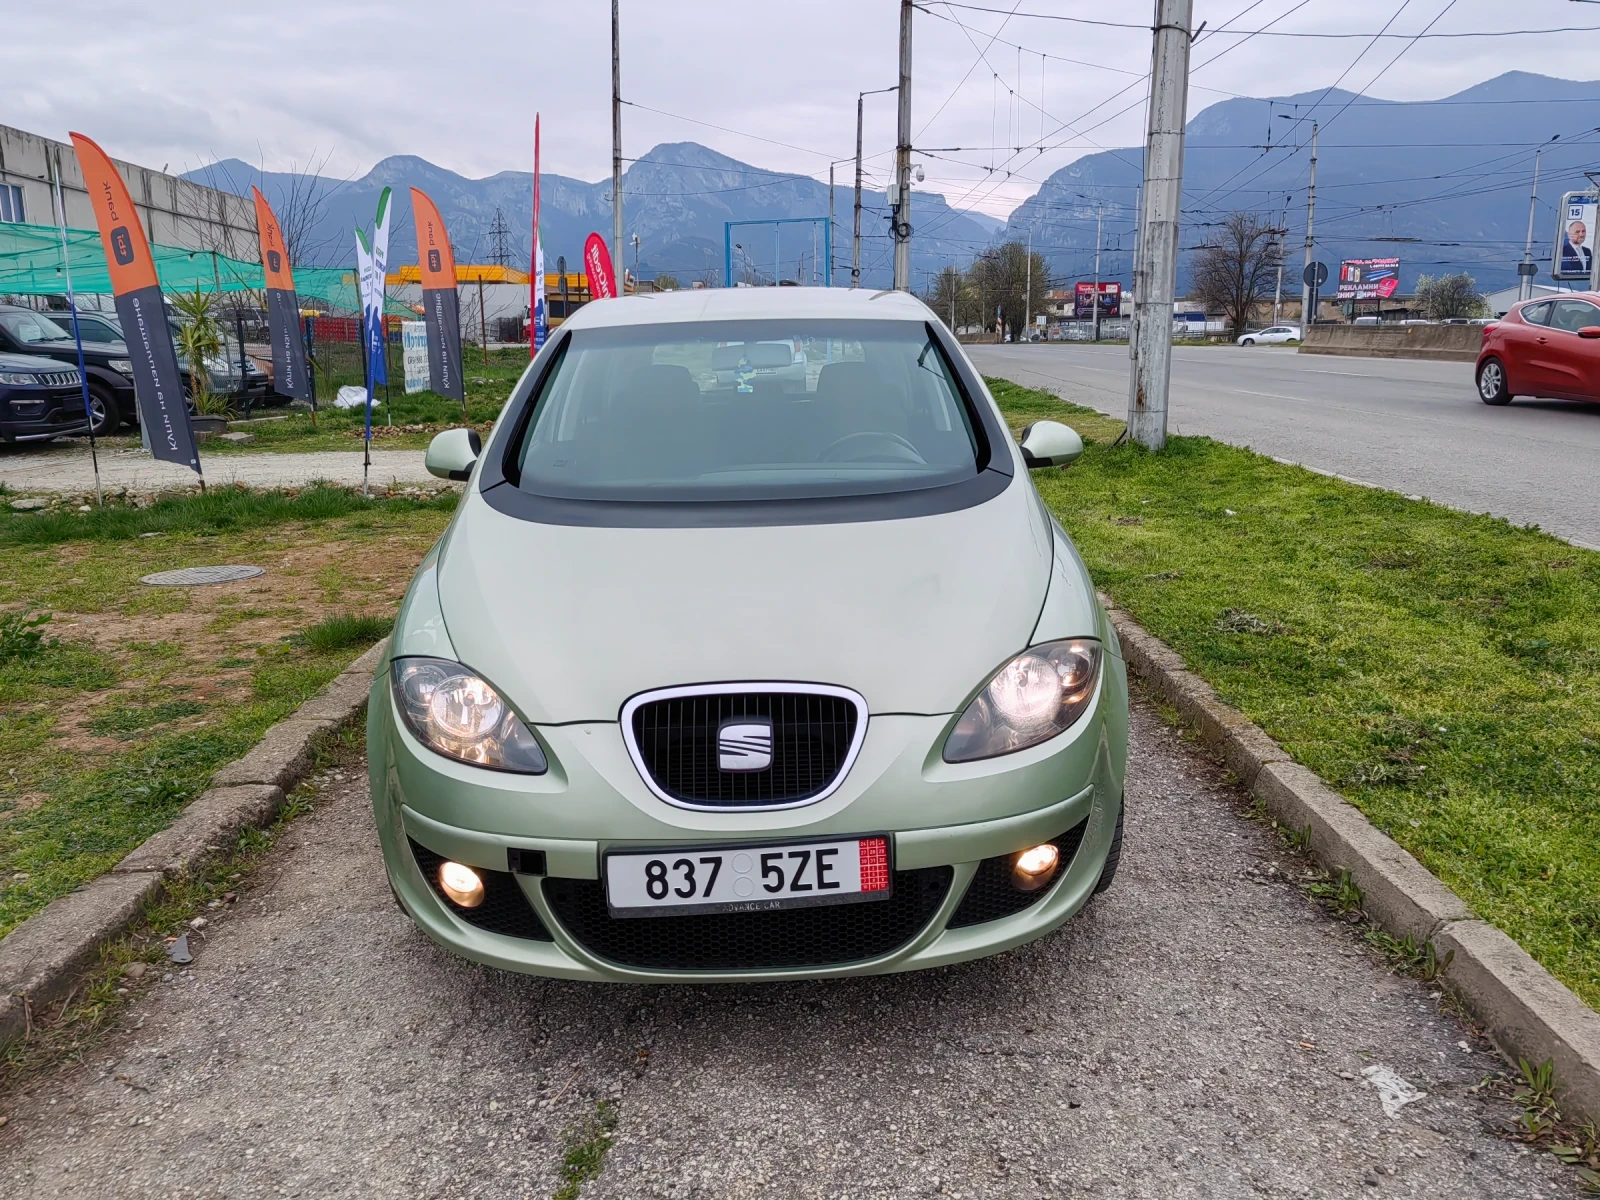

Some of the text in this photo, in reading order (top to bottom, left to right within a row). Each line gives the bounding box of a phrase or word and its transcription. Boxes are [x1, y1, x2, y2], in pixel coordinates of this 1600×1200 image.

[1570, 208, 1581, 217] 15
[645, 848, 840, 900] 837 5ZE
[722, 900, 781, 912] ADVANCE CAR
